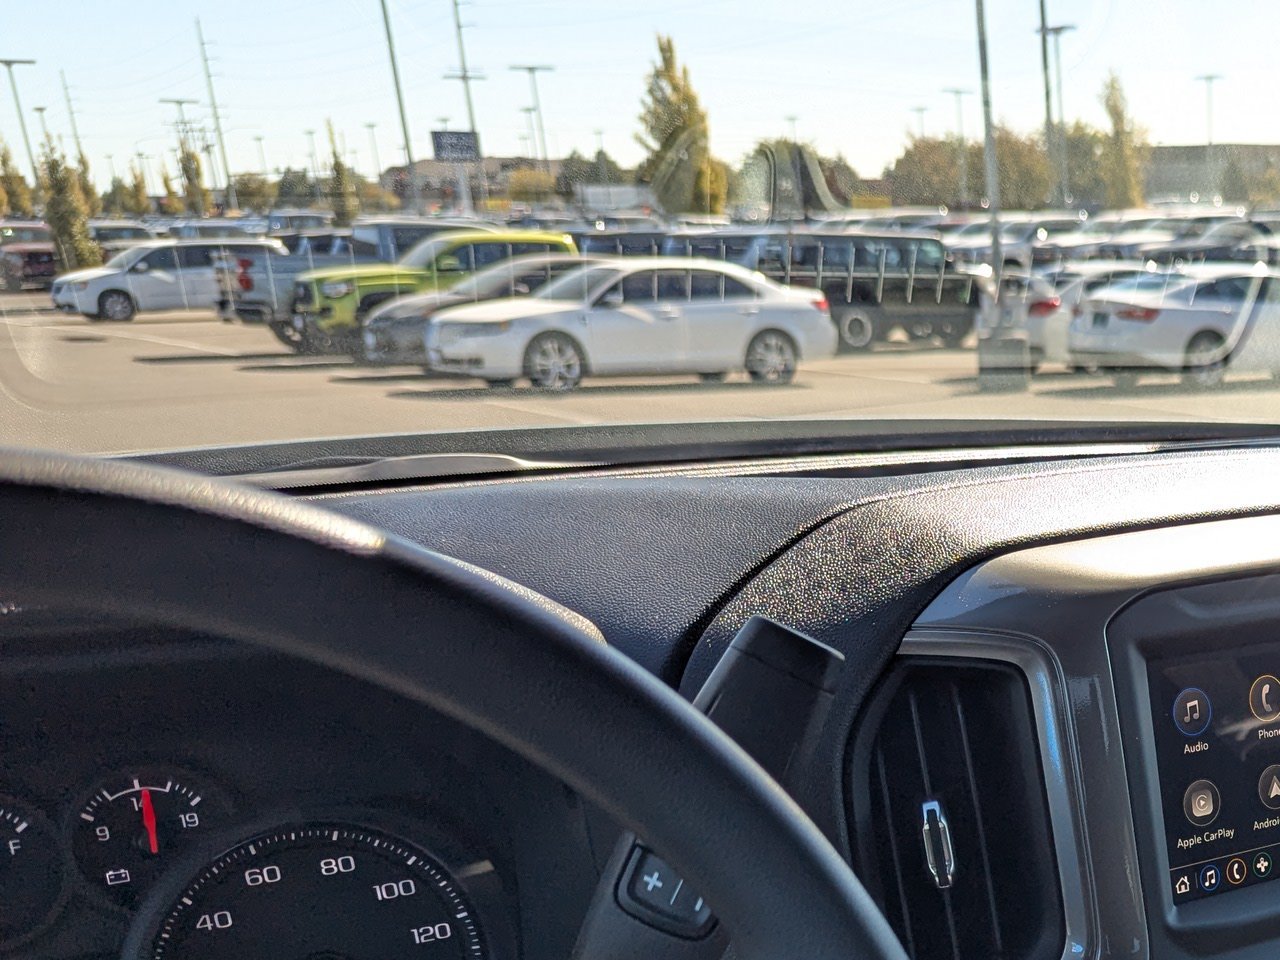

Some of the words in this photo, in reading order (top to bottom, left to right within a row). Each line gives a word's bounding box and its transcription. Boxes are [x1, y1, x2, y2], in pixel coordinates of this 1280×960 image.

[1183, 741, 1209, 754] Audio
[179, 812, 200, 829] 19
[95, 825, 110, 842] 9
[1177, 835, 1202, 850] Apple
[1203, 827, 1235, 845] CarPlay
[8, 839, 22, 855] F
[244, 865, 282, 886] 60
[320, 855, 357, 876] 80
[373, 879, 417, 901] 100
[195, 911, 234, 931] 40
[410, 922, 453, 944] 120
